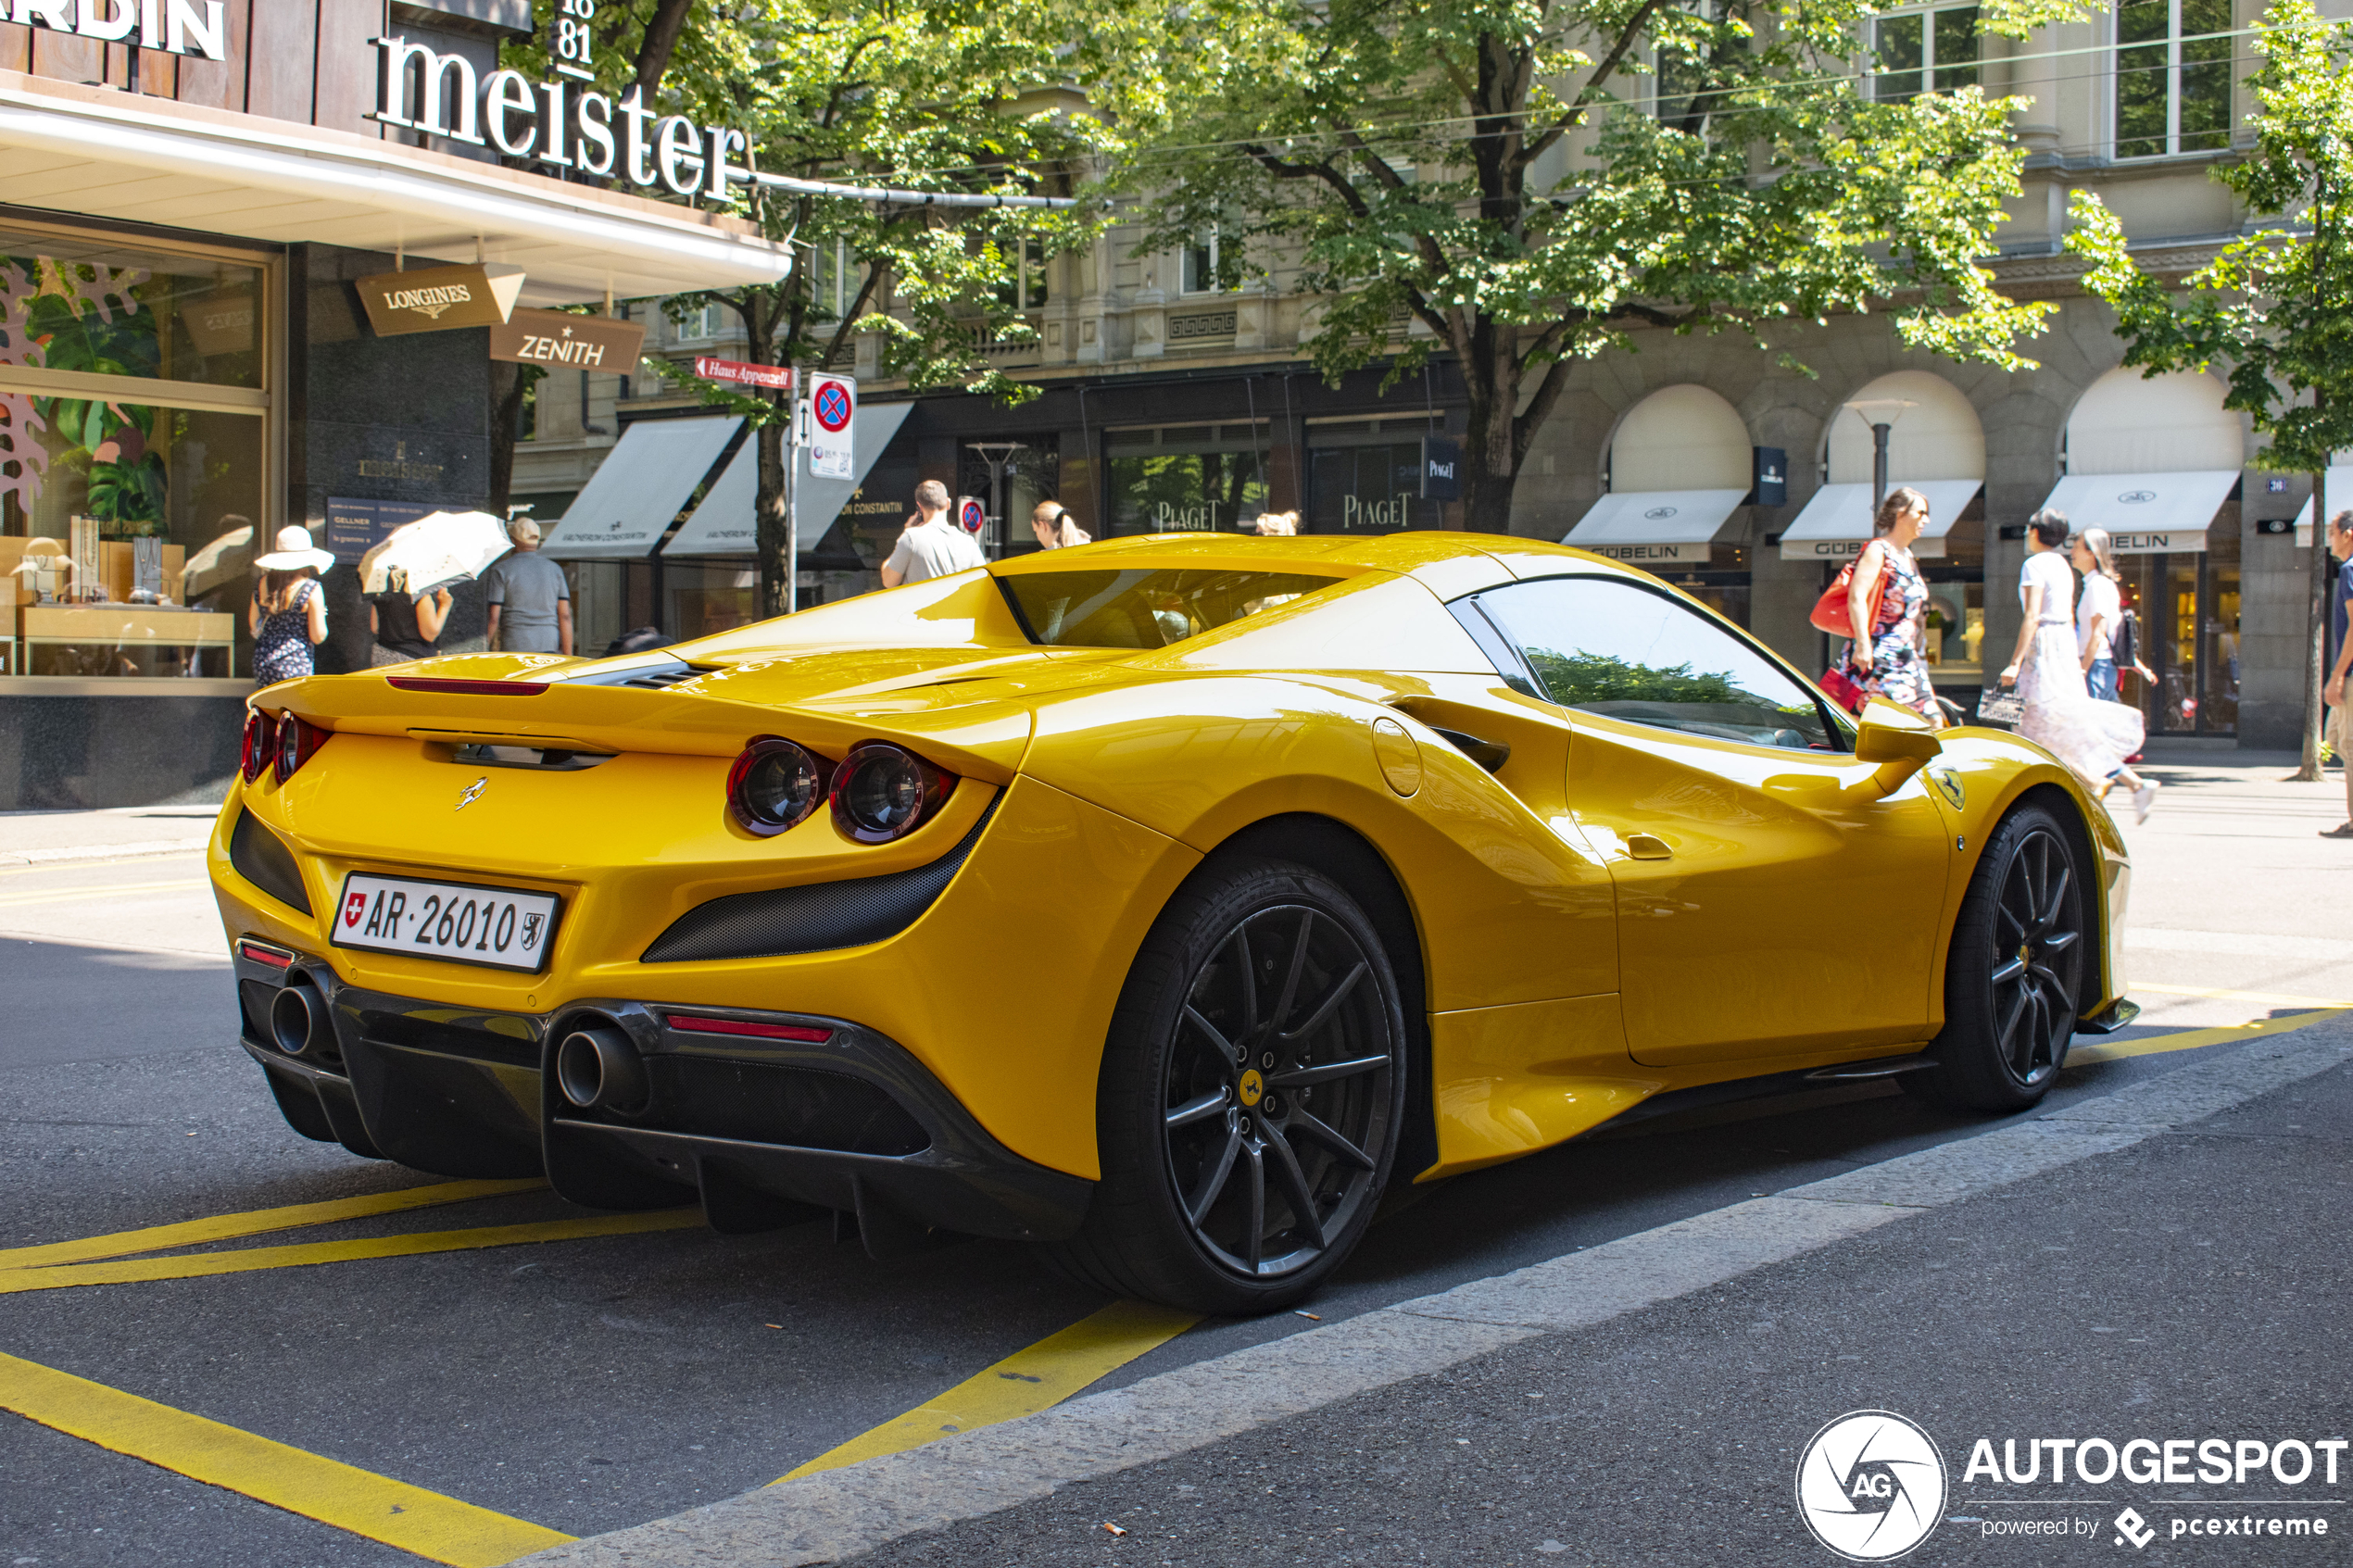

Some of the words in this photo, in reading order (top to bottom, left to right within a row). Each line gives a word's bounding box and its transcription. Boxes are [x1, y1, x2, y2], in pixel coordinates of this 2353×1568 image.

[558, 18, 592, 64] 81
[373, 35, 744, 203] meister
[383, 284, 471, 309] LONGINES
[517, 334, 605, 366] ZENITH
[709, 361, 737, 378] Haus
[737, 367, 788, 385] Appenzell
[1429, 460, 1454, 479] PIAGET
[2270, 480, 2284, 492] 36
[333, 516, 371, 525] GELLNER
[853, 501, 902, 515] CONSTANTIN
[1159, 499, 1221, 533] PIAGET
[1344, 492, 1412, 528] PIAGET
